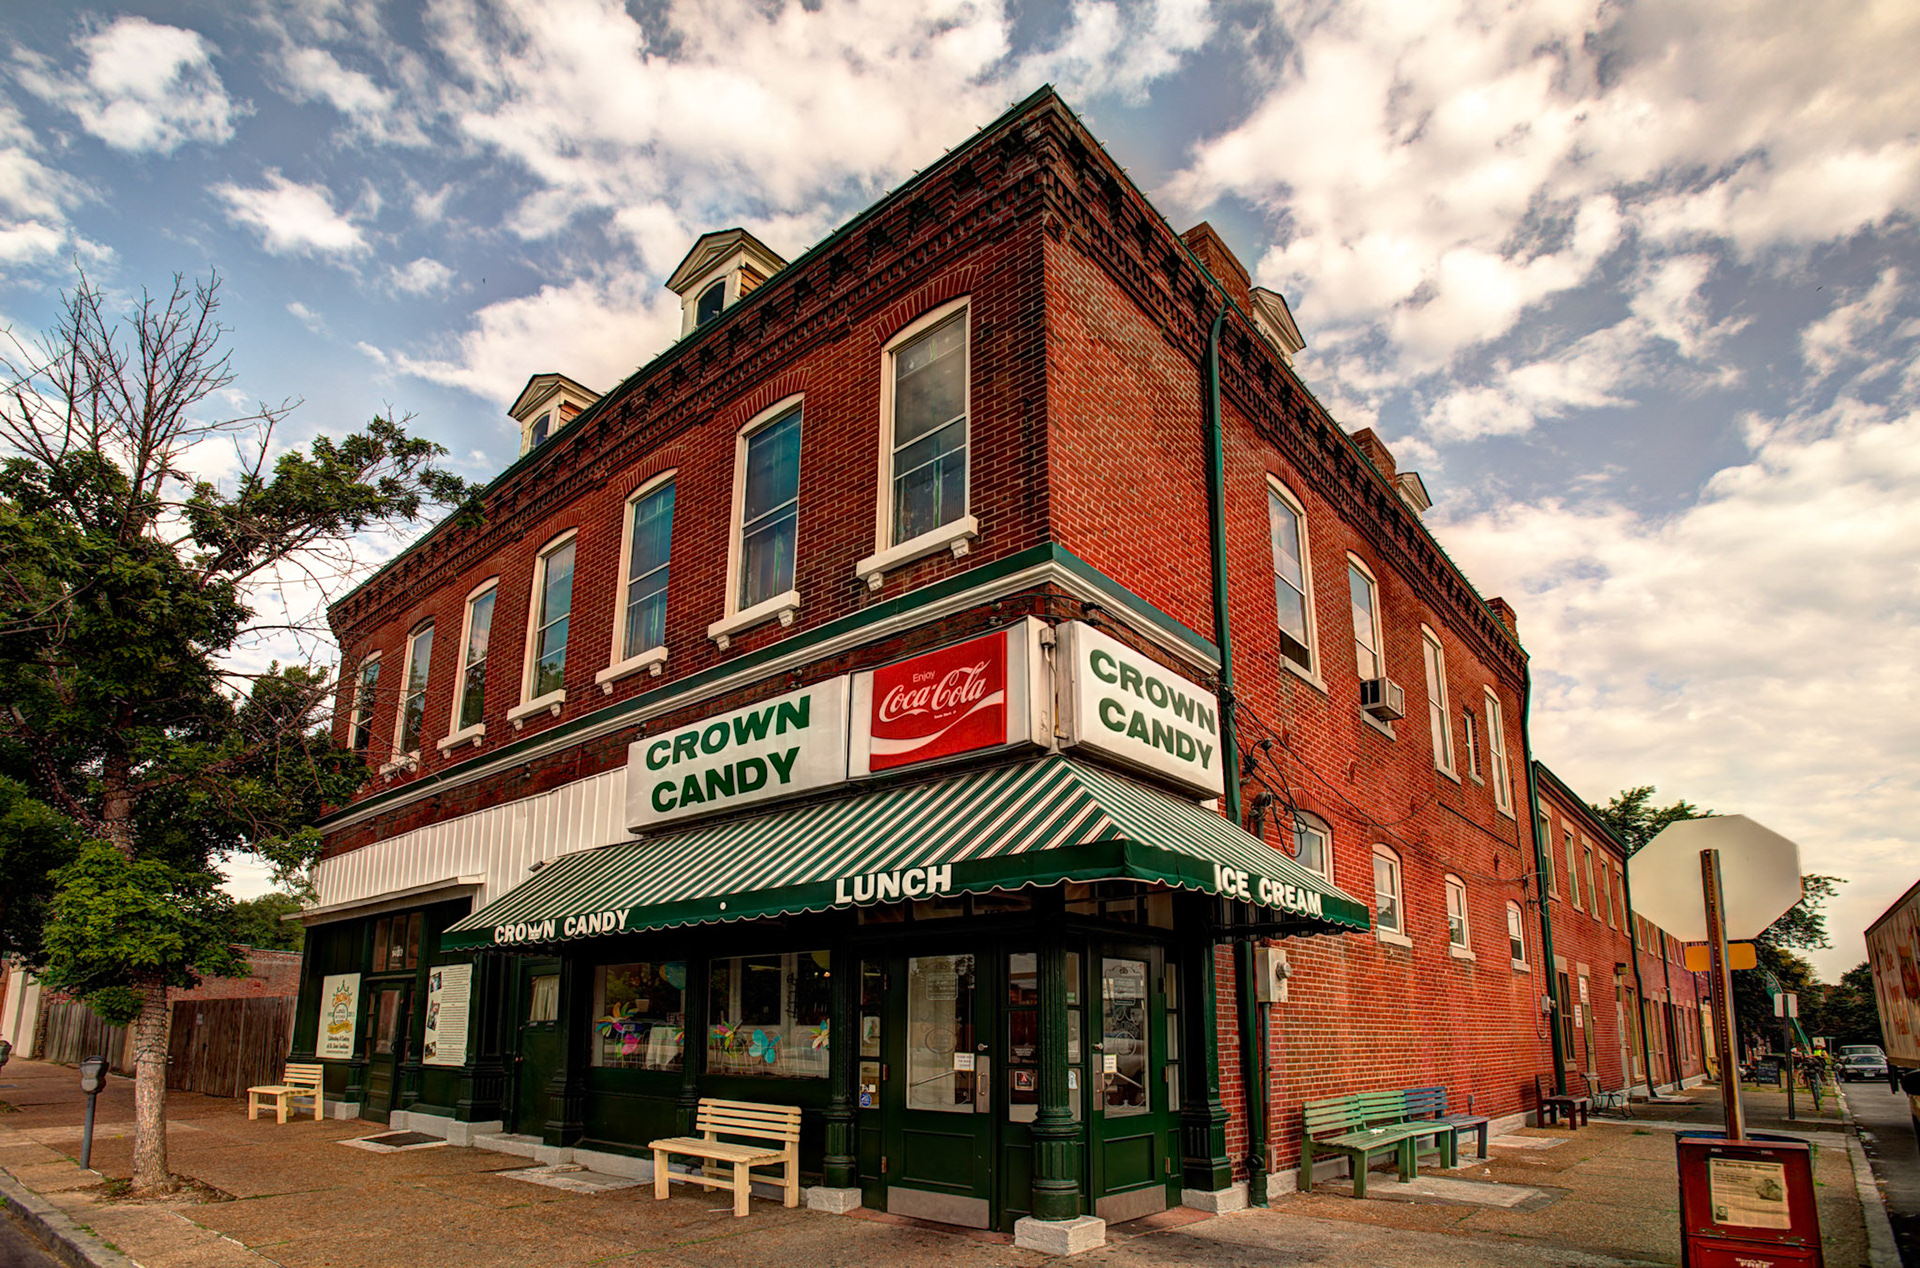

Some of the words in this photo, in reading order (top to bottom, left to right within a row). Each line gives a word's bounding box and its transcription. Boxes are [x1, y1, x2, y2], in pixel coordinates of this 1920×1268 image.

[912, 670, 936, 683] Enjoy
[1090, 649, 1216, 736] CROWN
[646, 695, 811, 771] CROWN
[1098, 697, 1213, 770] CANDY
[651, 746, 800, 813] CANDY
[835, 864, 952, 905] LUNCH
[1214, 863, 1251, 898] ICE
[1258, 877, 1323, 917] CREAM
[494, 918, 556, 943] CROWN
[563, 908, 630, 936] CANDY
